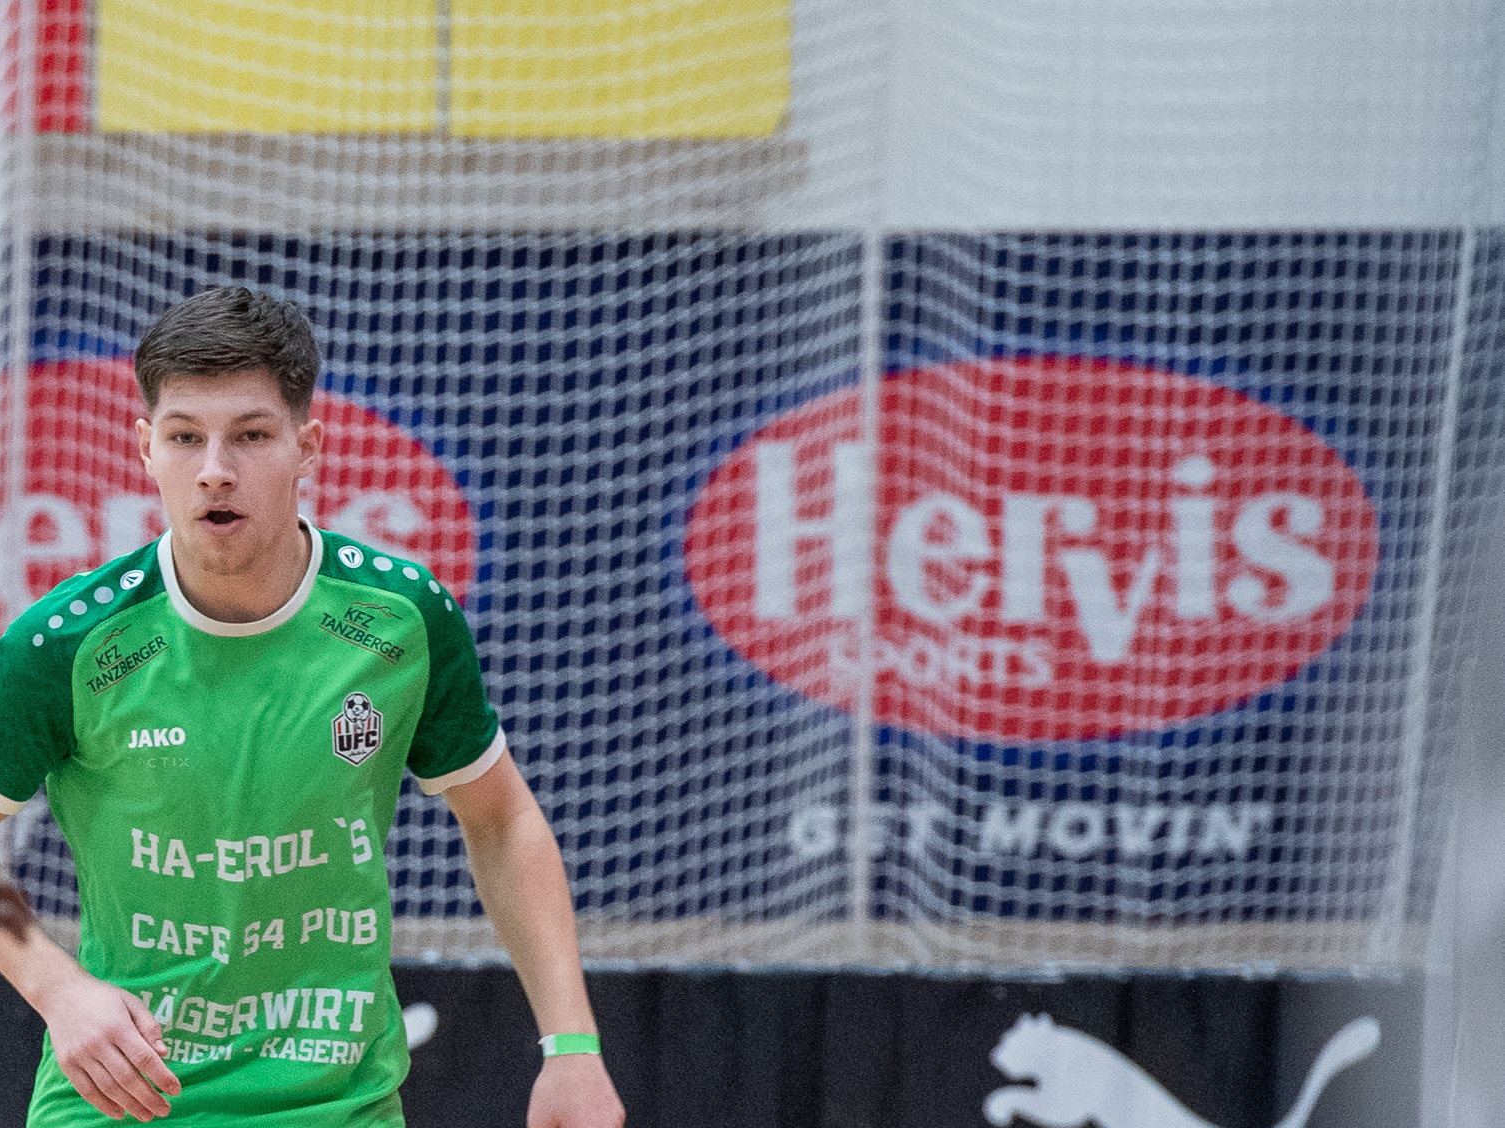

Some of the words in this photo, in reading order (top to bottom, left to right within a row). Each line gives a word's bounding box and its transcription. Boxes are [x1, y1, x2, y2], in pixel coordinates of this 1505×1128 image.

[755, 440, 1336, 662] Hervis
[321, 612, 405, 663] TANZBERGER
[343, 606, 376, 629] KFZ
[86, 635, 167, 693] TANZBERGER
[95, 644, 123, 670] KFZ
[128, 726, 186, 749] JAKO
[338, 730, 378, 752] UFC
[131, 827, 329, 883] HA-EROL
[131, 912, 231, 964] CAFE
[300, 907, 378, 946] PUB
[259, 1036, 366, 1065] KASERN
